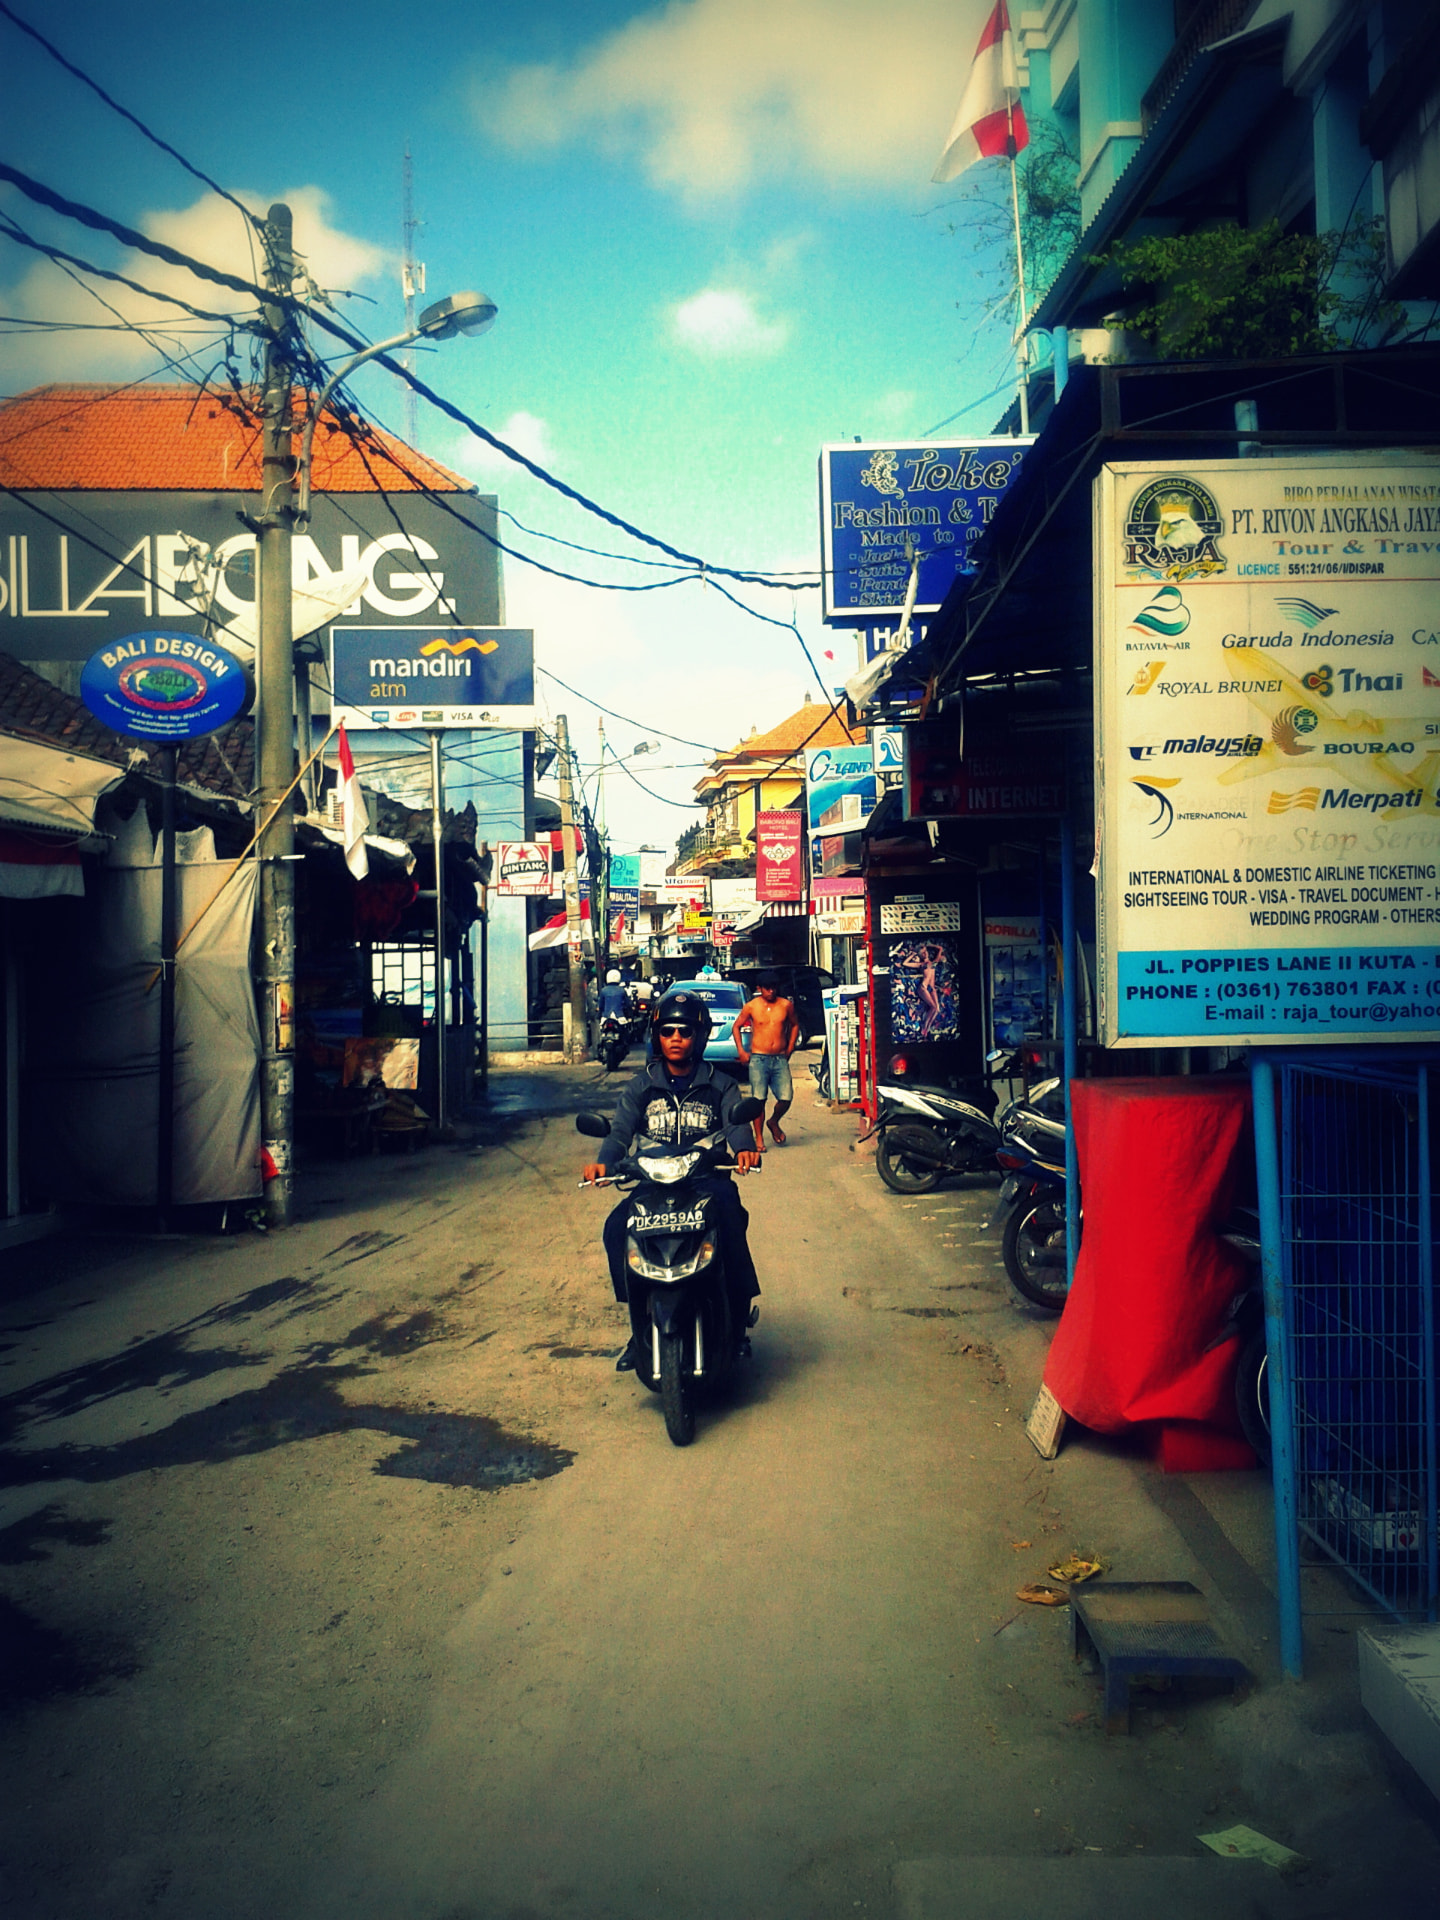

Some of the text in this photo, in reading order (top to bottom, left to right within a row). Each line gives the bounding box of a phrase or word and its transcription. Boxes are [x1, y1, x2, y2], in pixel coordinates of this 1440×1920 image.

[1283, 486, 1313, 503] BIRO
[834, 501, 940, 529] Fashion
[949, 498, 973, 524] &
[1232, 510, 1257, 535] PT.
[1262, 509, 1315, 535] RIVON
[1320, 508, 1401, 534] ANGKASA
[861, 529, 921, 547] Made
[933, 527, 955, 544] to
[1126, 541, 1225, 568] RAJA
[1273, 540, 1333, 556] Tour
[1343, 539, 1365, 555] &
[0, 534, 457, 618] ILLABONG.
[1237, 564, 1280, 576] LICENCE
[1126, 642, 1191, 652] BATAVIA AIR
[1221, 630, 1440, 650] Garuda Indonesia CA
[101, 638, 230, 679] BALI DESIGN
[370, 653, 472, 678] mandiri
[370, 681, 407, 698] atm
[1157, 679, 1283, 698] ROYAL BRUNEI
[1337, 668, 1403, 692] Thai
[451, 713, 474, 721] VISA
[1163, 735, 1264, 757] malaysia
[1324, 741, 1415, 756] BOURAQ
[968, 786, 1062, 809] INTERNET
[1321, 788, 1423, 814] Merpati
[1177, 811, 1249, 821] INTERNATIONAL
[1289, 826, 1358, 860] Stop
[502, 861, 547, 875] BINTANG
[1129, 869, 1230, 886] INTERNATIONAL
[1232, 869, 1243, 883] &
[1246, 868, 1312, 883] DOMESTIC
[1315, 866, 1366, 882] AIRLINE
[1369, 865, 1437, 880] TICKETING
[1124, 892, 1209, 908] SIGHTSEEING
[1212, 890, 1248, 905] TOUR
[1259, 889, 1288, 904] VISA
[1299, 888, 1347, 904] TRAVEL
[1351, 887, 1424, 903] DOCUMENT
[901, 910, 941, 920] FCS
[1250, 911, 1311, 926] WEDDING
[1314, 909, 1380, 925] PROGRAM
[985, 924, 1038, 938] GORILLA
[1145, 960, 1174, 975] JL.
[1182, 958, 1270, 974] POPPIES
[1278, 956, 1331, 971] LANE
[1338, 956, 1352, 970] II
[1359, 956, 1415, 970] KUTA
[1126, 985, 1198, 1001] PHONE
[1217, 983, 1281, 1002] (0361)
[1287, 983, 1359, 997] 763801
[1367, 981, 1407, 996] FAX
[1205, 1005, 1265, 1021] E-mail
[648, 1111, 709, 1131] DIVINE
